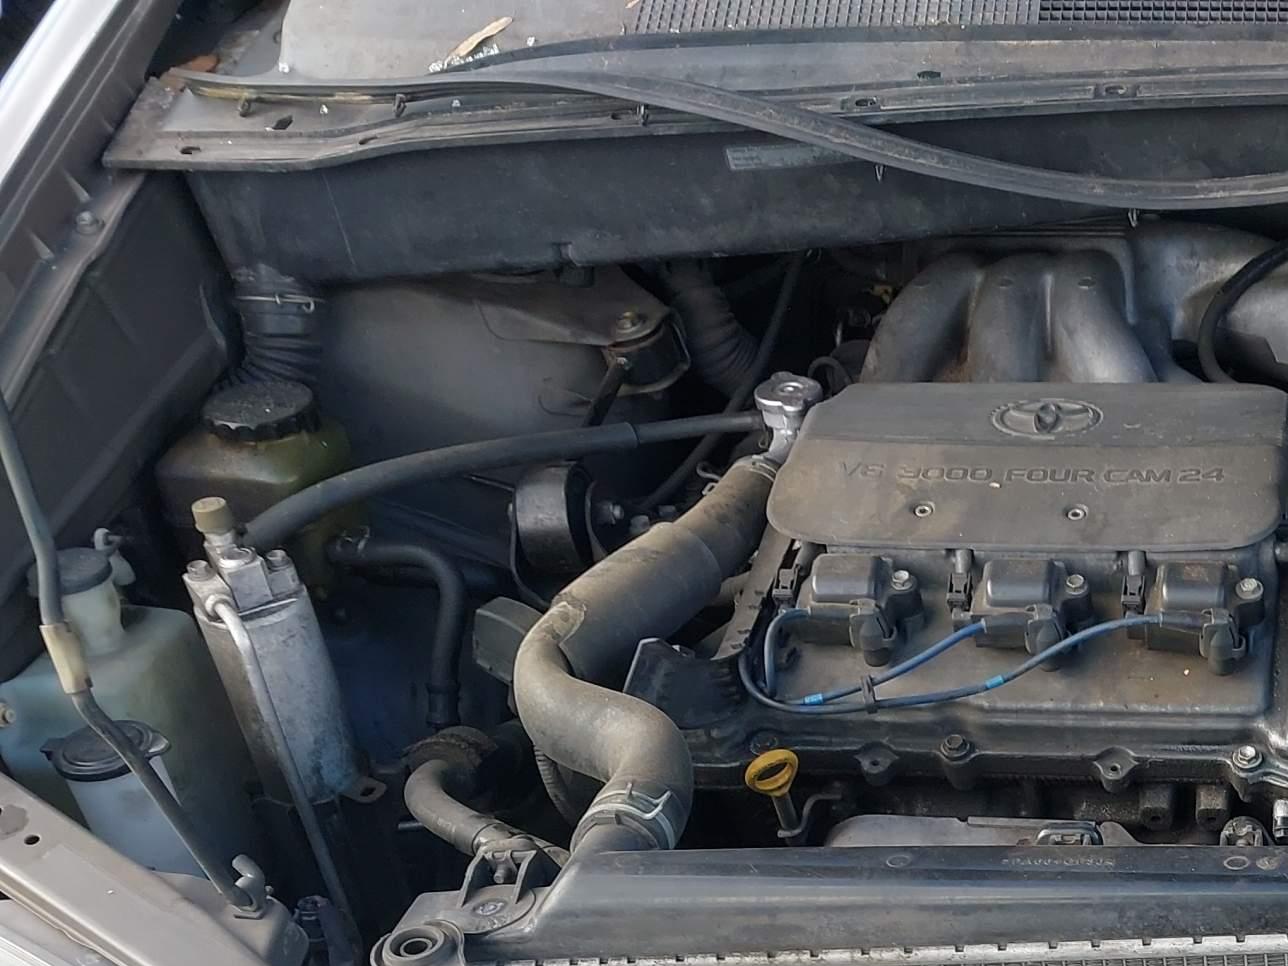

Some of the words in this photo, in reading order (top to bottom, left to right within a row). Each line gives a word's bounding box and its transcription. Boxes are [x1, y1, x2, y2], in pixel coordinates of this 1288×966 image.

[840, 462, 884, 477] V6
[1005, 467, 1095, 483] FOUR
[1103, 467, 1172, 483] CAM
[1178, 467, 1225, 482] 24
